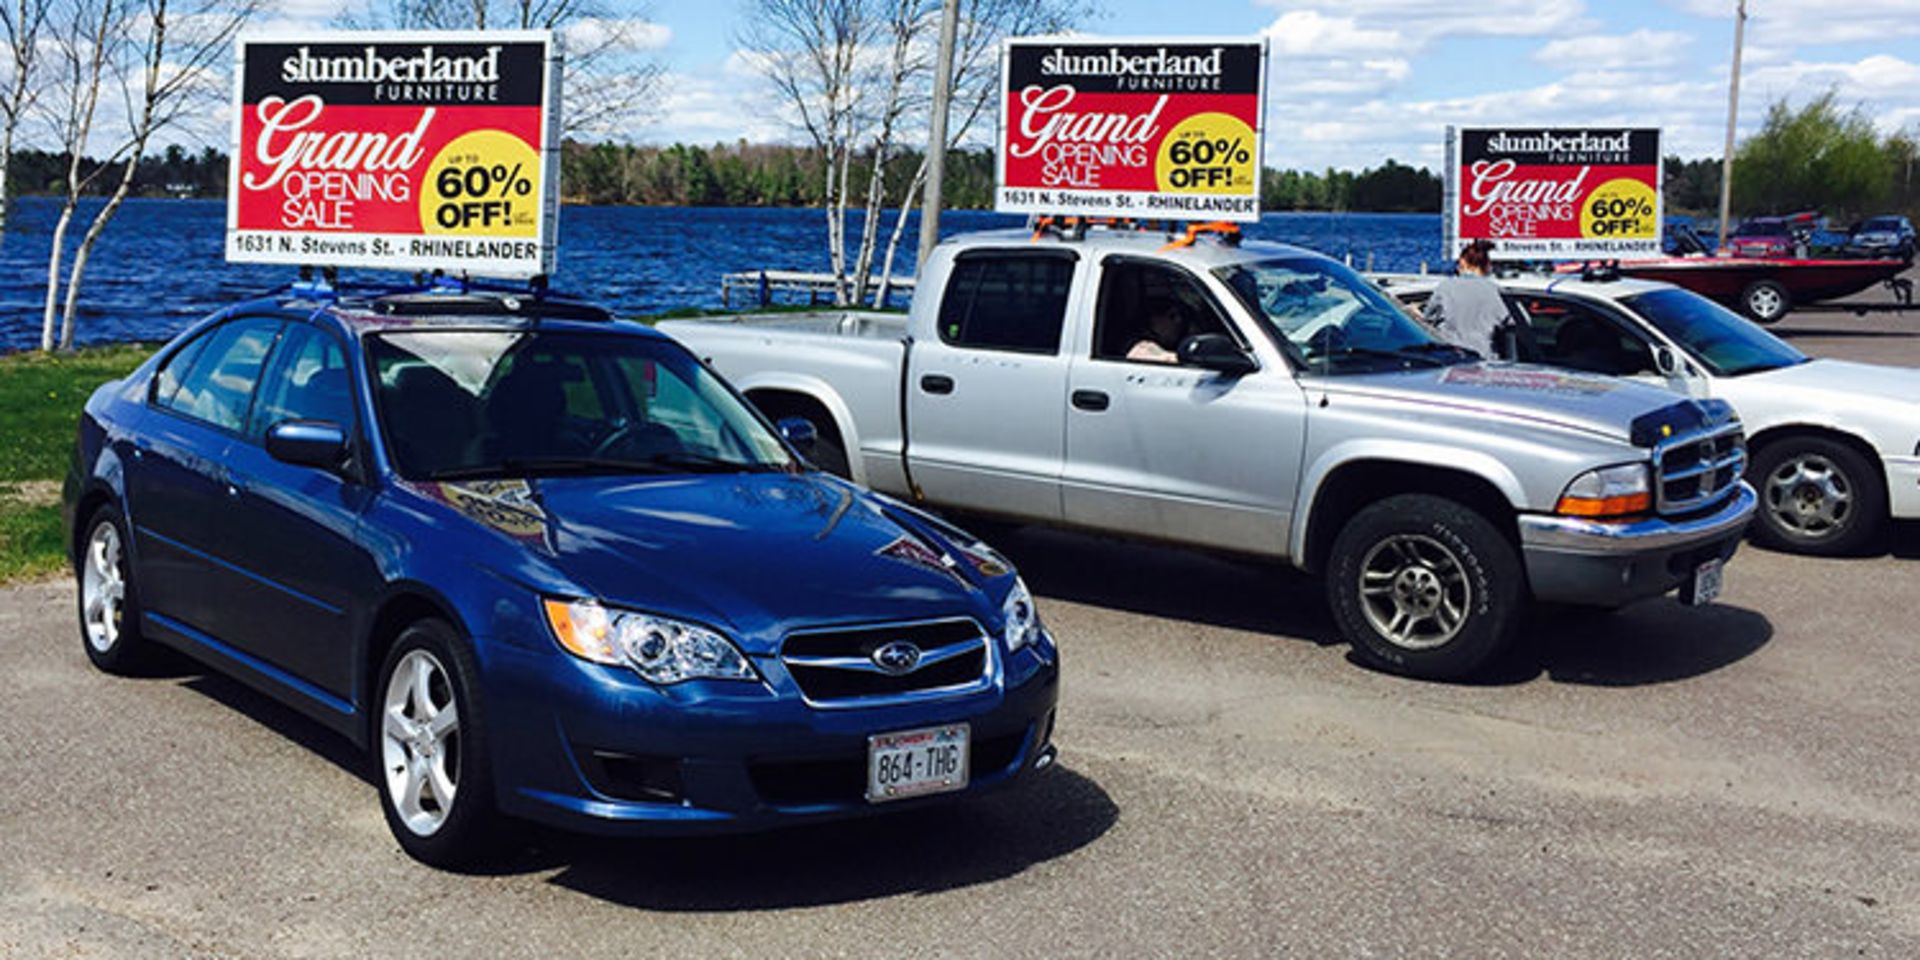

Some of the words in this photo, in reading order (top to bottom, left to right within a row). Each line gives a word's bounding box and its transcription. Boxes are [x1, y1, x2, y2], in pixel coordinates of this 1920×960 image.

[282, 46, 502, 82] slumberland
[1041, 48, 1224, 76] slumberland
[374, 84, 498, 100] FURNITURE
[1116, 76, 1221, 91] FURNITURE
[1010, 84, 1168, 158] Grand
[243, 94, 436, 191] Grand
[1169, 137, 1249, 166] 60%
[1487, 131, 1631, 153] slumberland
[1041, 143, 1147, 168] OPENING
[282, 171, 410, 201] OPENING
[437, 163, 532, 199] 60%
[1041, 165, 1100, 188] SALE
[1169, 166, 1232, 189] OFF!
[1464, 159, 1590, 216] Grand
[1004, 190, 1035, 204] 1631
[1039, 191, 1054, 205] N.
[1058, 192, 1111, 207] Stevens
[1115, 193, 1134, 208] St.
[1146, 194, 1254, 213] RHINELANDER
[1489, 203, 1574, 221] OPENING
[1591, 196, 1652, 218] 60%
[281, 201, 353, 229] SALE
[437, 202, 511, 229] OFF!
[1591, 218, 1639, 236] OFF!
[1489, 219, 1537, 237] SALE
[235, 235, 272, 252] 1631
[279, 237, 296, 253] N.
[301, 238, 367, 255] Stevens
[371, 238, 395, 256] St.
[409, 240, 537, 260] RHINELANDER
[1575, 241, 1657, 253] RHINELANDER
[878, 744, 958, 784] 864-THG
